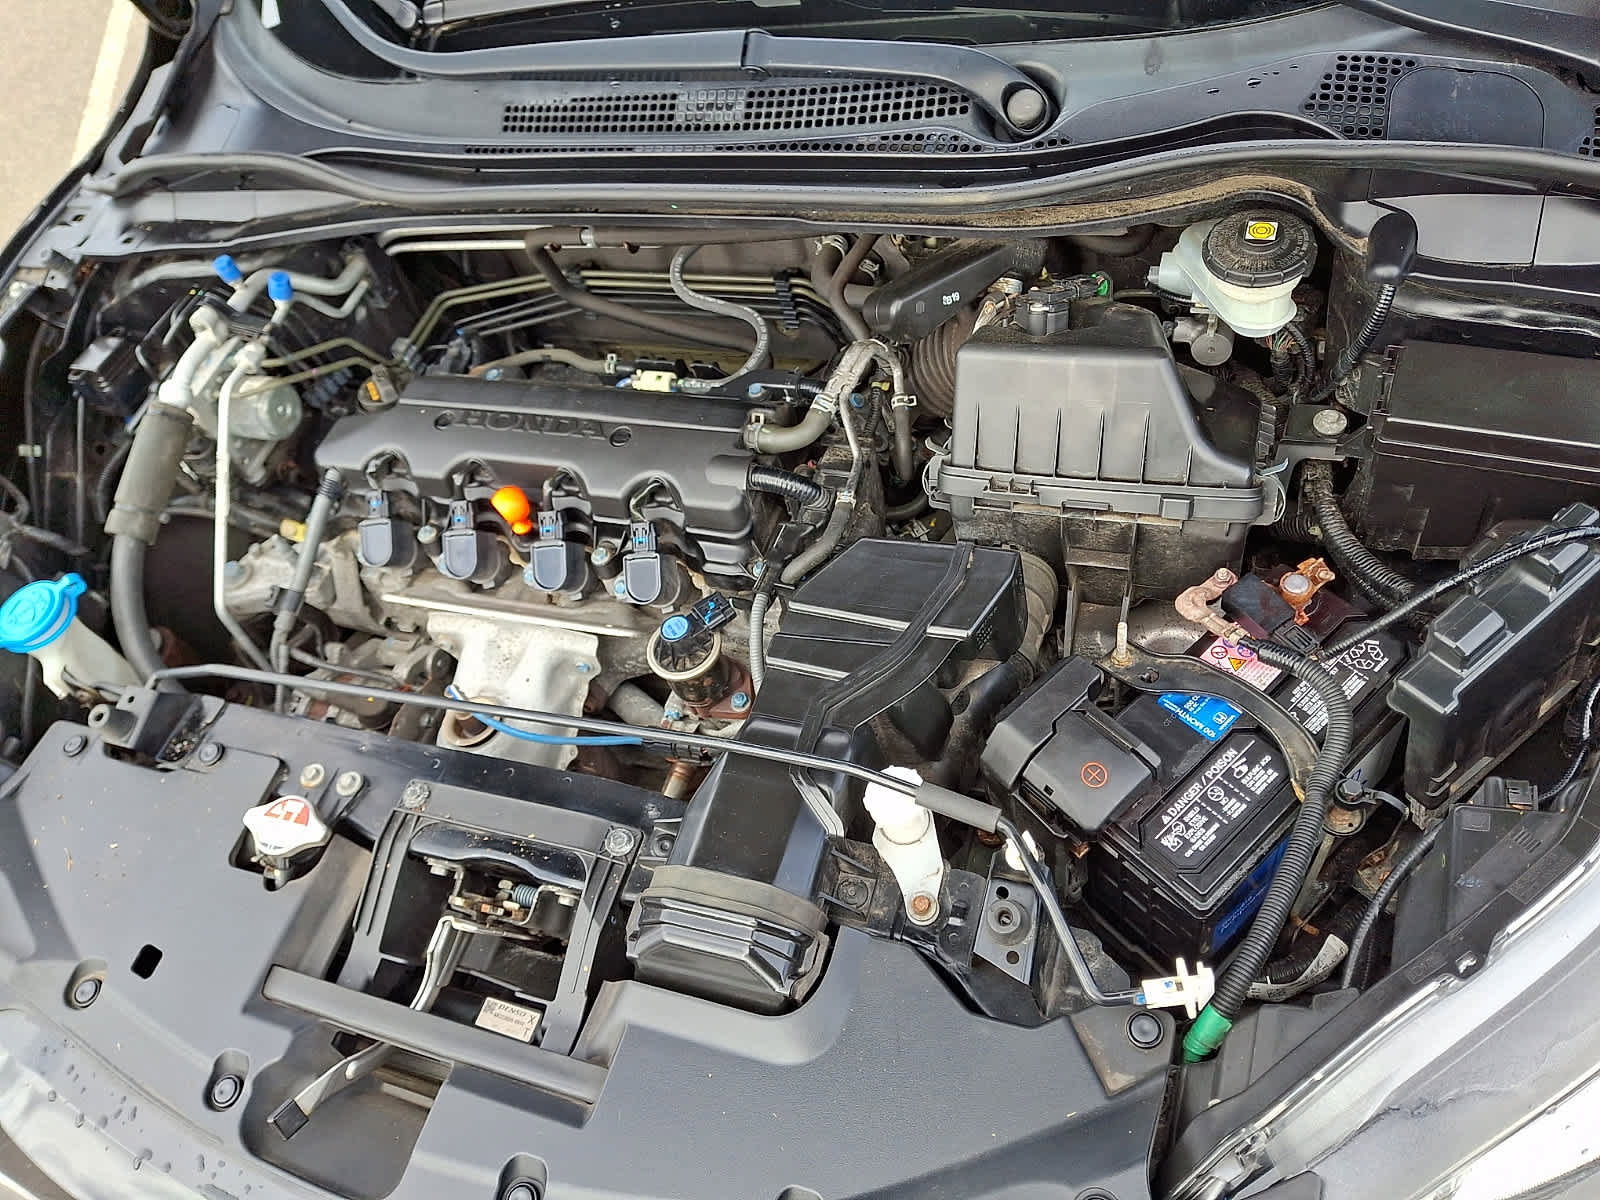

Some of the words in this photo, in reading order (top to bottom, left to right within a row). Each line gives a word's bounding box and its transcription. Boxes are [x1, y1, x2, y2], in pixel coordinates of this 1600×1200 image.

[453, 409, 607, 440] HONDA
[1176, 708, 1204, 731] MONTH
[1167, 782, 1203, 817] DANGER
[1204, 747, 1238, 780] POISON
